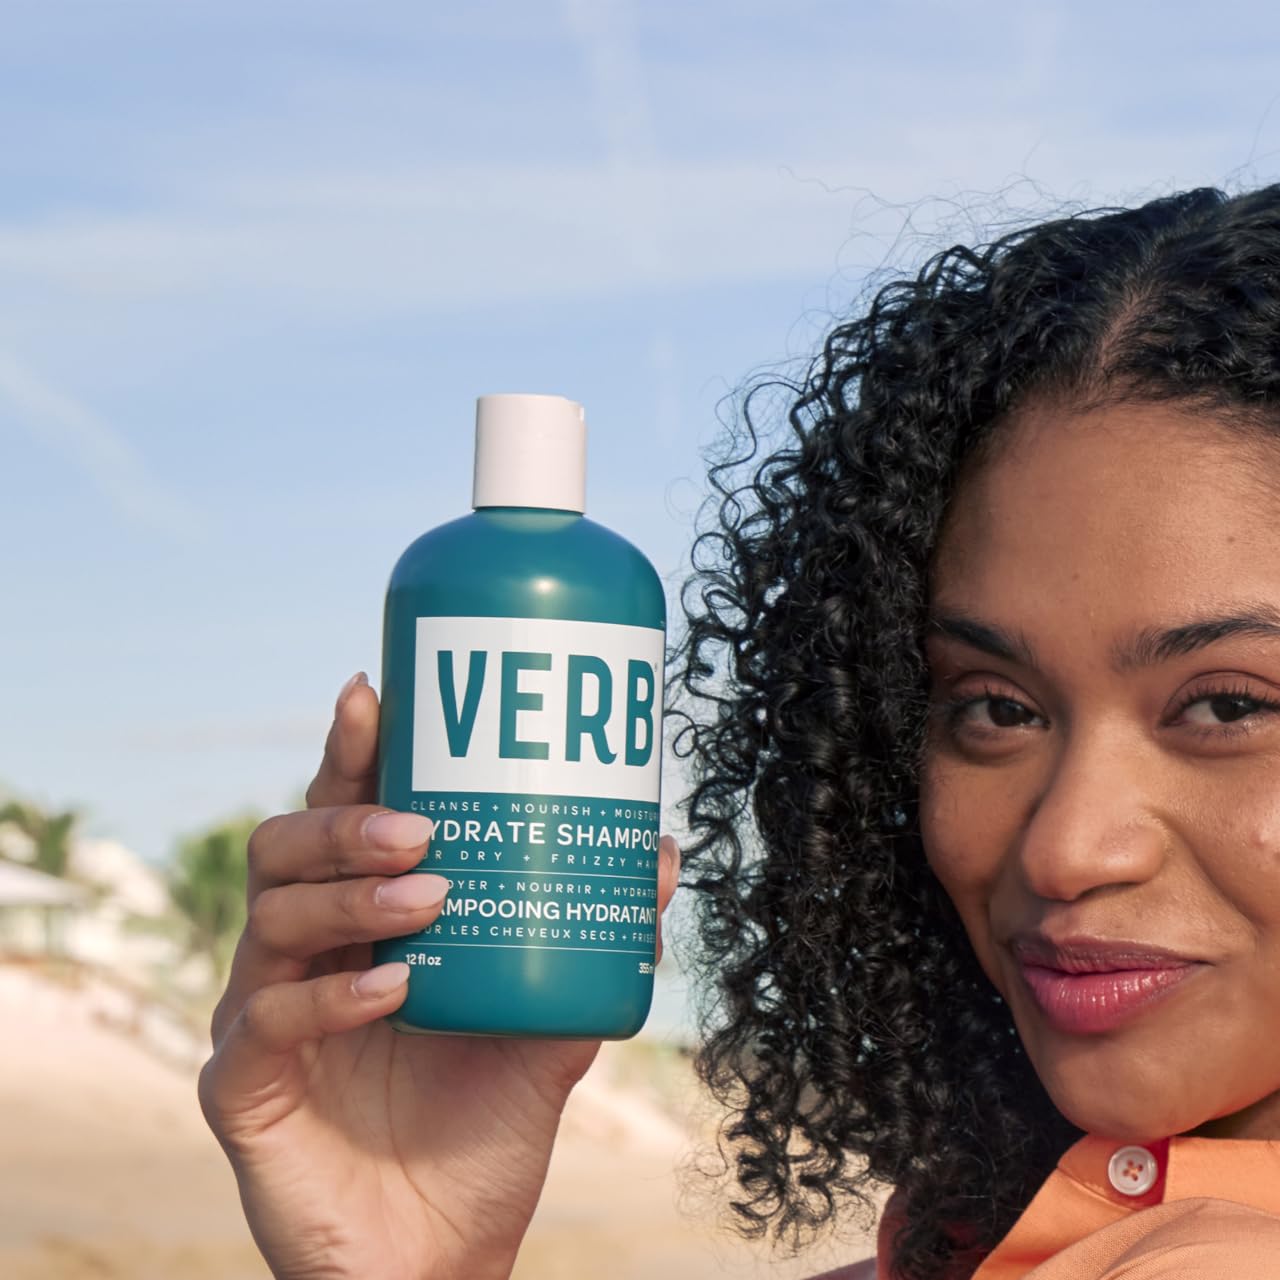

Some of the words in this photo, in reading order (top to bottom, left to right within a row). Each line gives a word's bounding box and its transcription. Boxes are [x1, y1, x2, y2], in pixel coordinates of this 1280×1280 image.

[436, 649, 656, 768] VERB
[411, 800, 481, 812] CLEANSE
[511, 803, 591, 816] NOURISH
[429, 820, 546, 845] YDRATE
[460, 850, 503, 861] DRY
[551, 854, 626, 867] FRIZZY
[448, 879, 488, 890] OYER
[516, 882, 592, 895] NOURRIR
[440, 898, 560, 920] MPOOING
[566, 903, 657, 925] HYDRATANT
[451, 925, 480, 936] LES
[489, 926, 571, 939] CHEVEUX
[580, 929, 616, 942] SECS
[405, 953, 417, 965] 12
[418, 953, 426, 965] fl
[427, 955, 442, 966] oz
